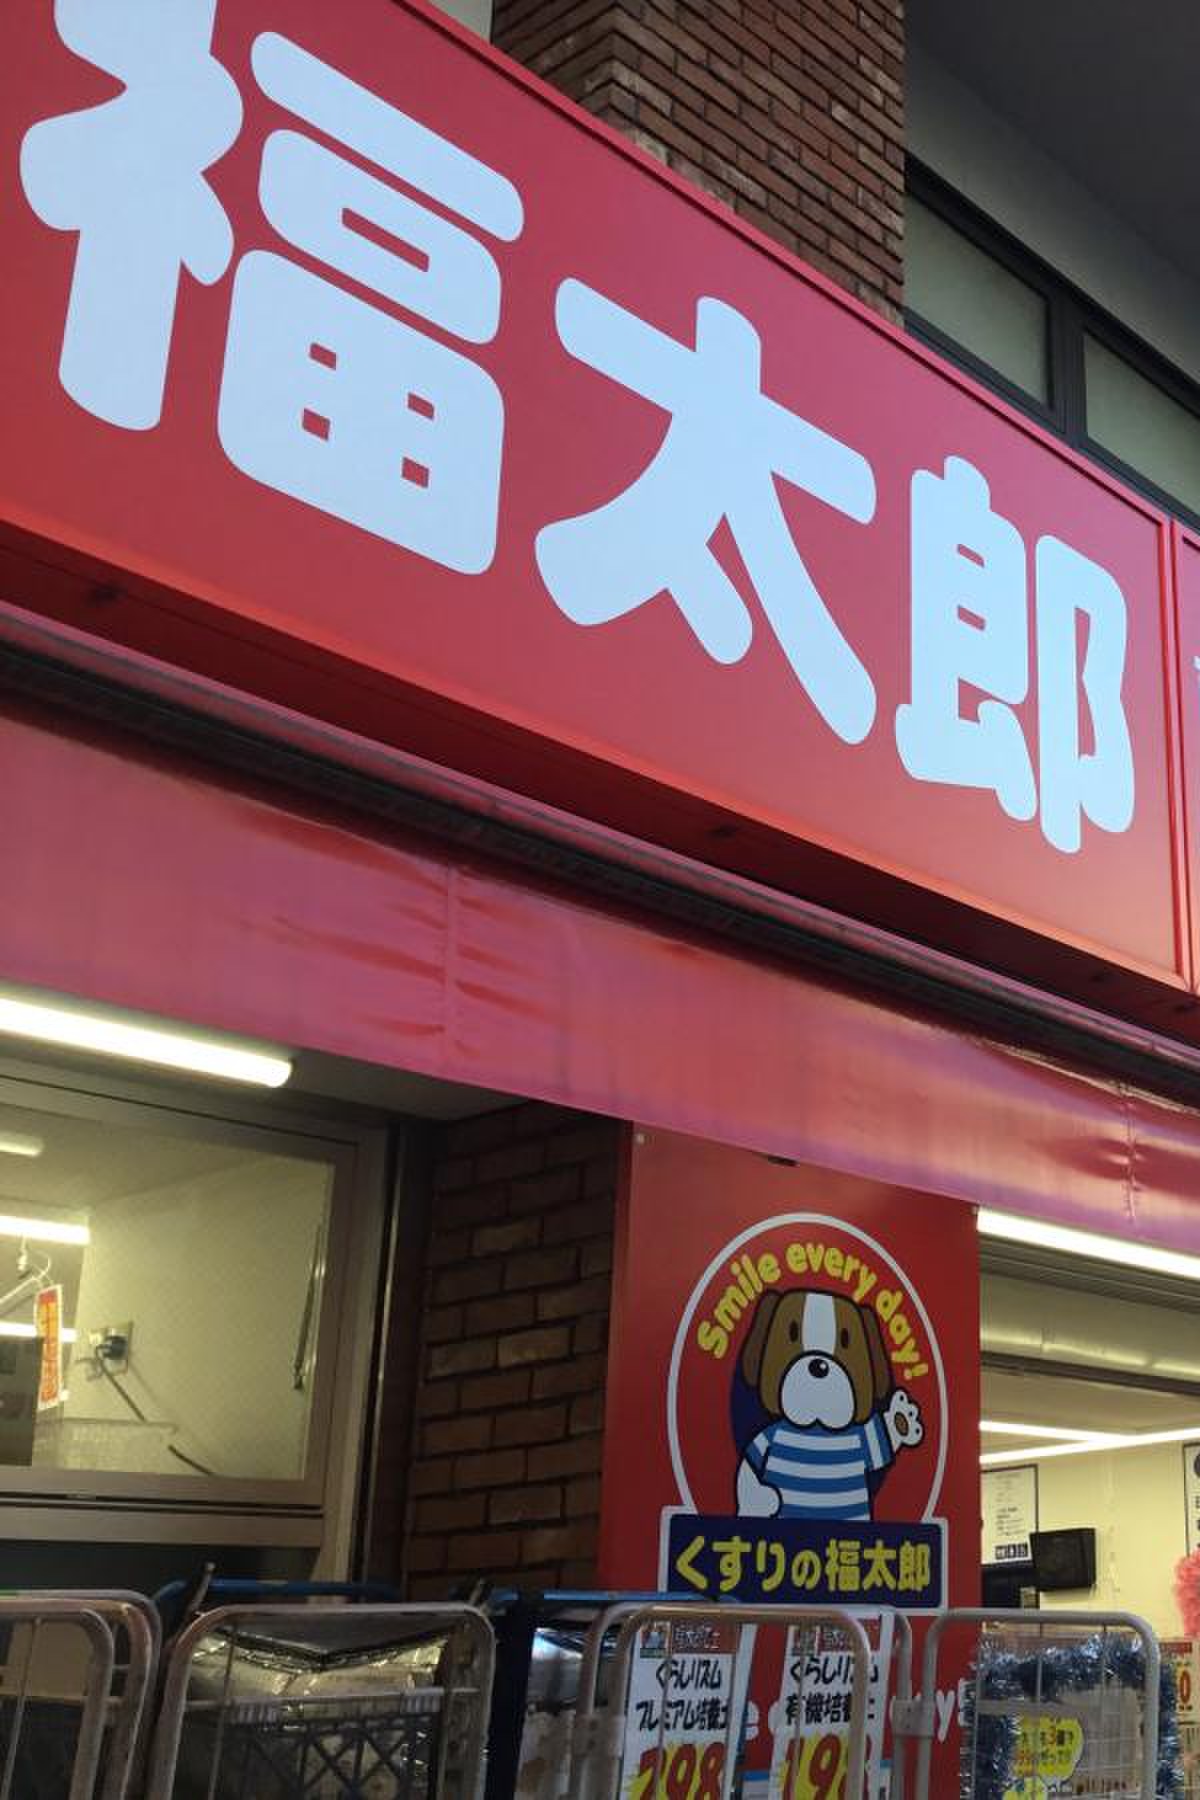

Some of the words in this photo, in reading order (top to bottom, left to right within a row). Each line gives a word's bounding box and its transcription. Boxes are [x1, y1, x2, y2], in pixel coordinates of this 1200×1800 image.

[20, 0, 1134, 854] 福太郎
[697, 1254, 782, 1359] Smile
[786, 1243, 877, 1301] every
[876, 1289, 929, 1380] day!
[675, 1536, 930, 1592] くすりの福太郎
